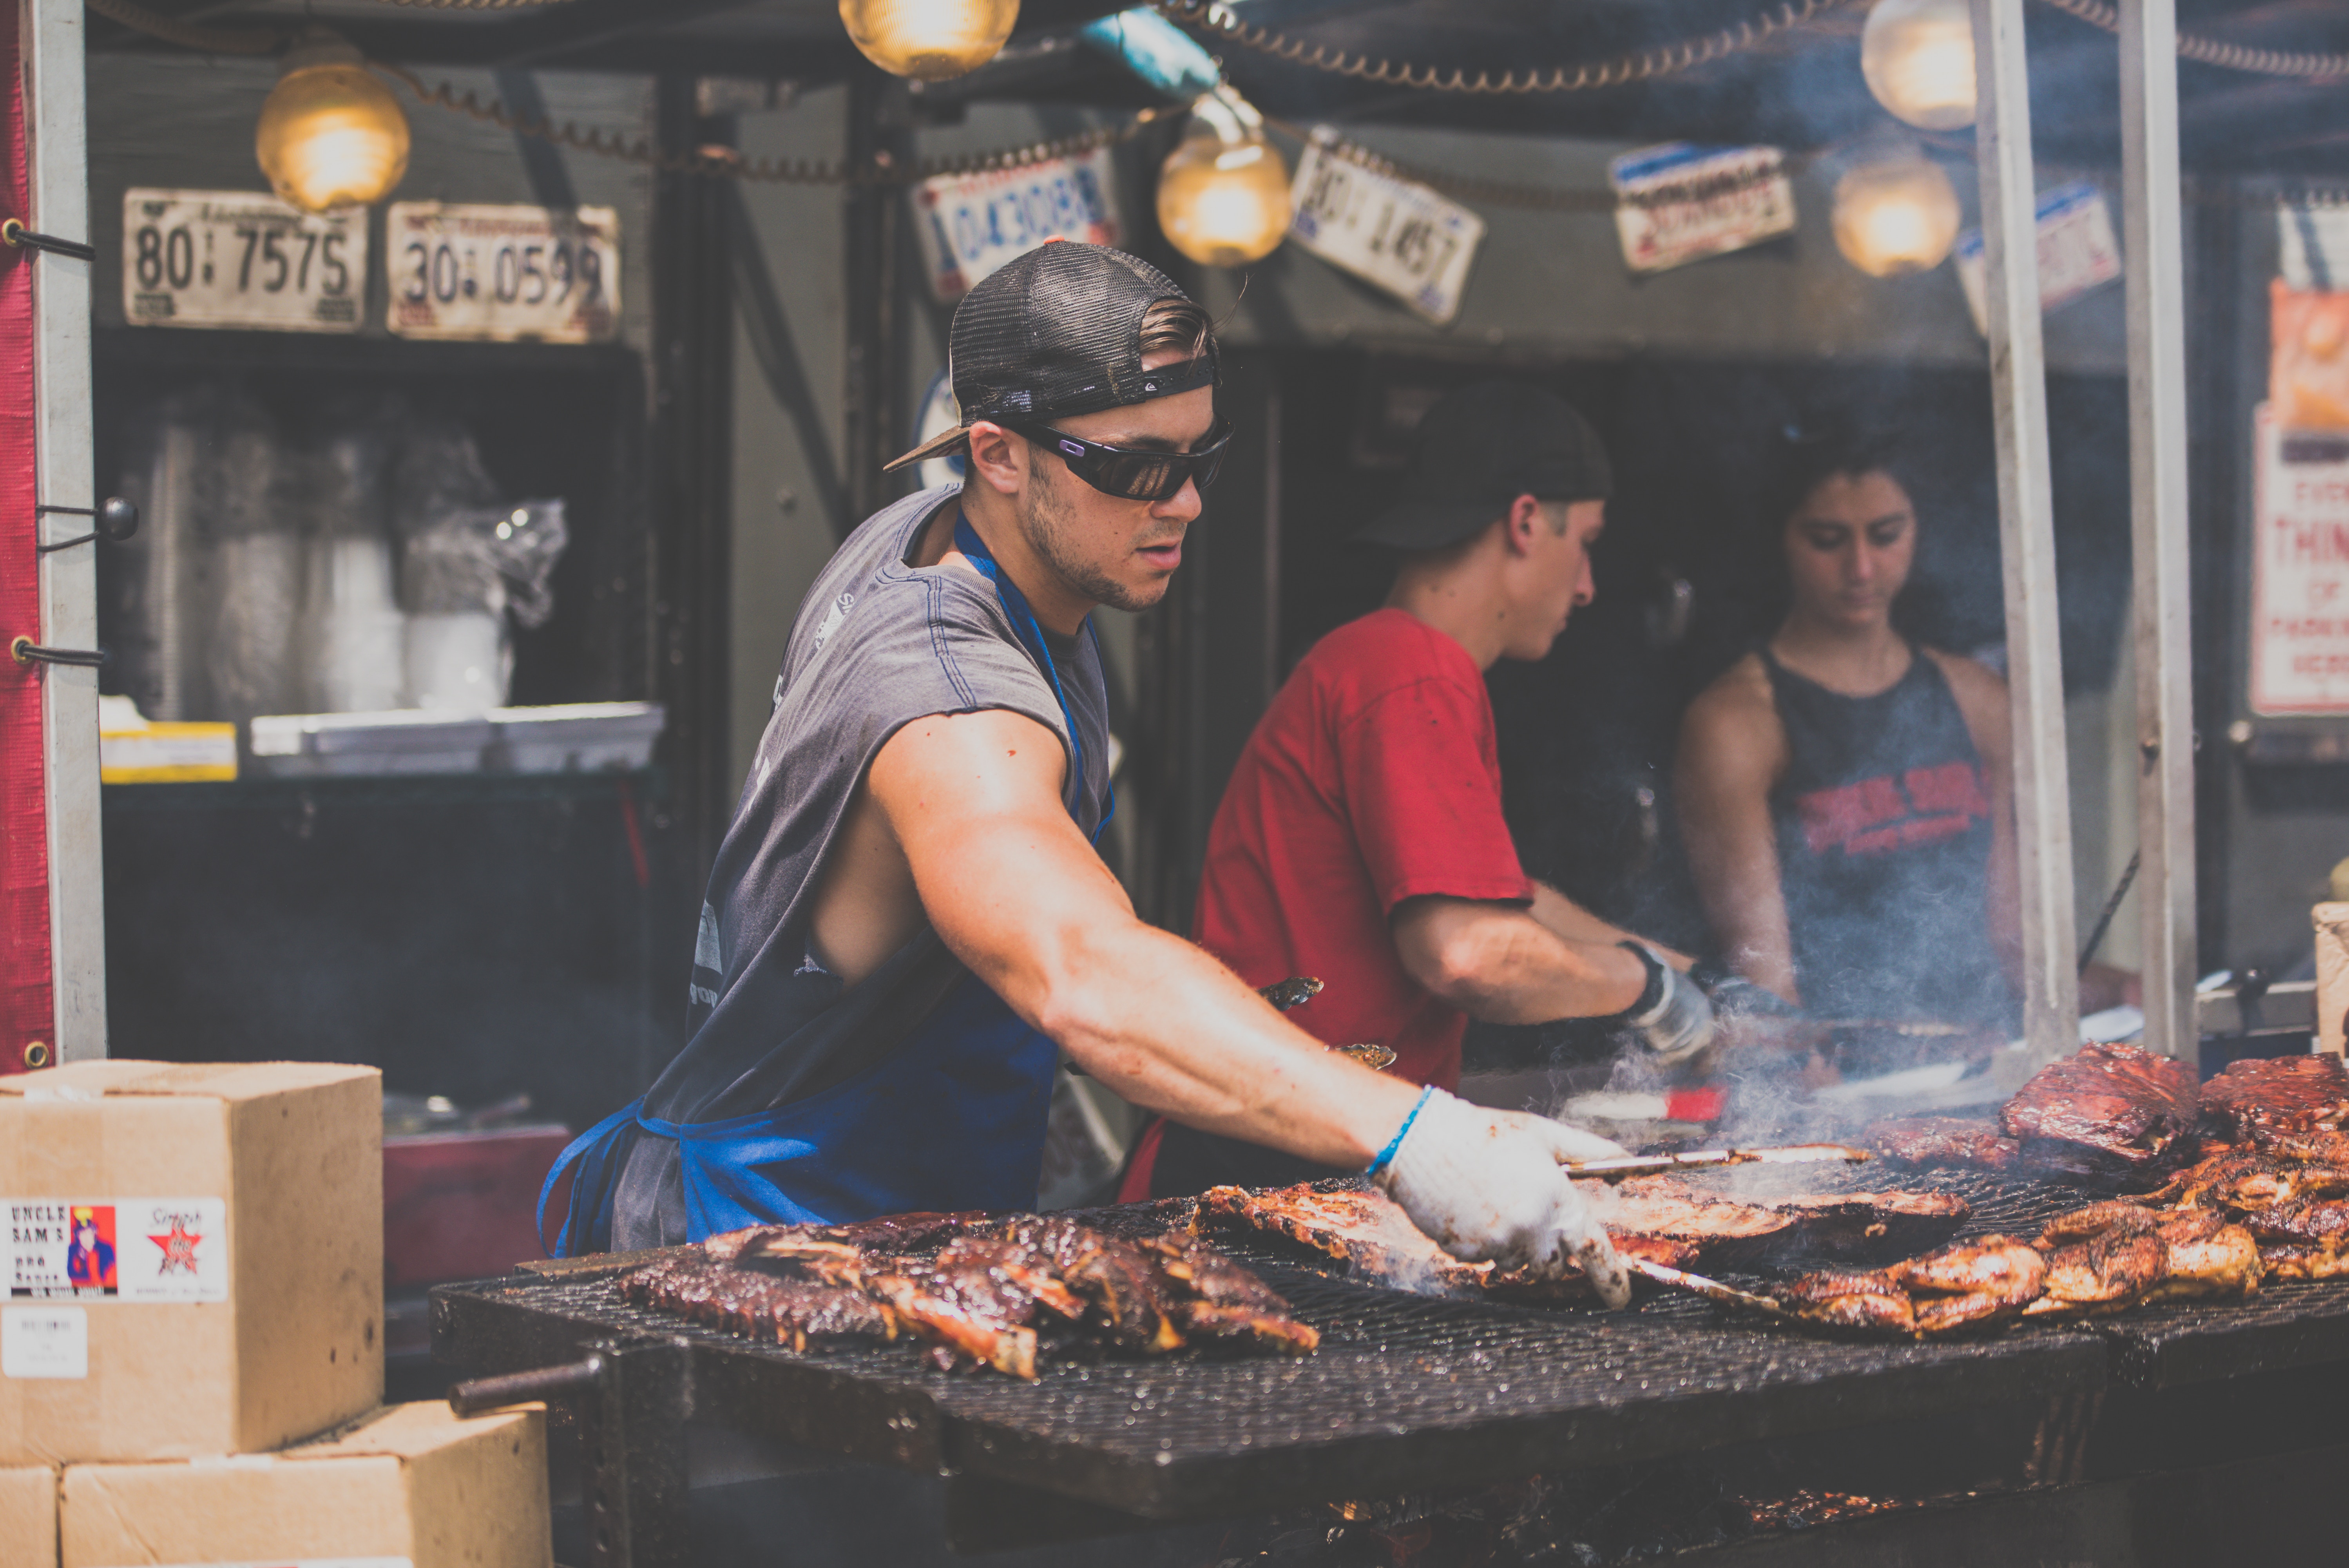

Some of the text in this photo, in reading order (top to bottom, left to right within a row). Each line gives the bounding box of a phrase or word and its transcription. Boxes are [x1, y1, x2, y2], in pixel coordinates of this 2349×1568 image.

[137, 224, 194, 291] 80
[405, 239, 601, 306] 30 0599
[12, 1206, 65, 1222] UNCLE
